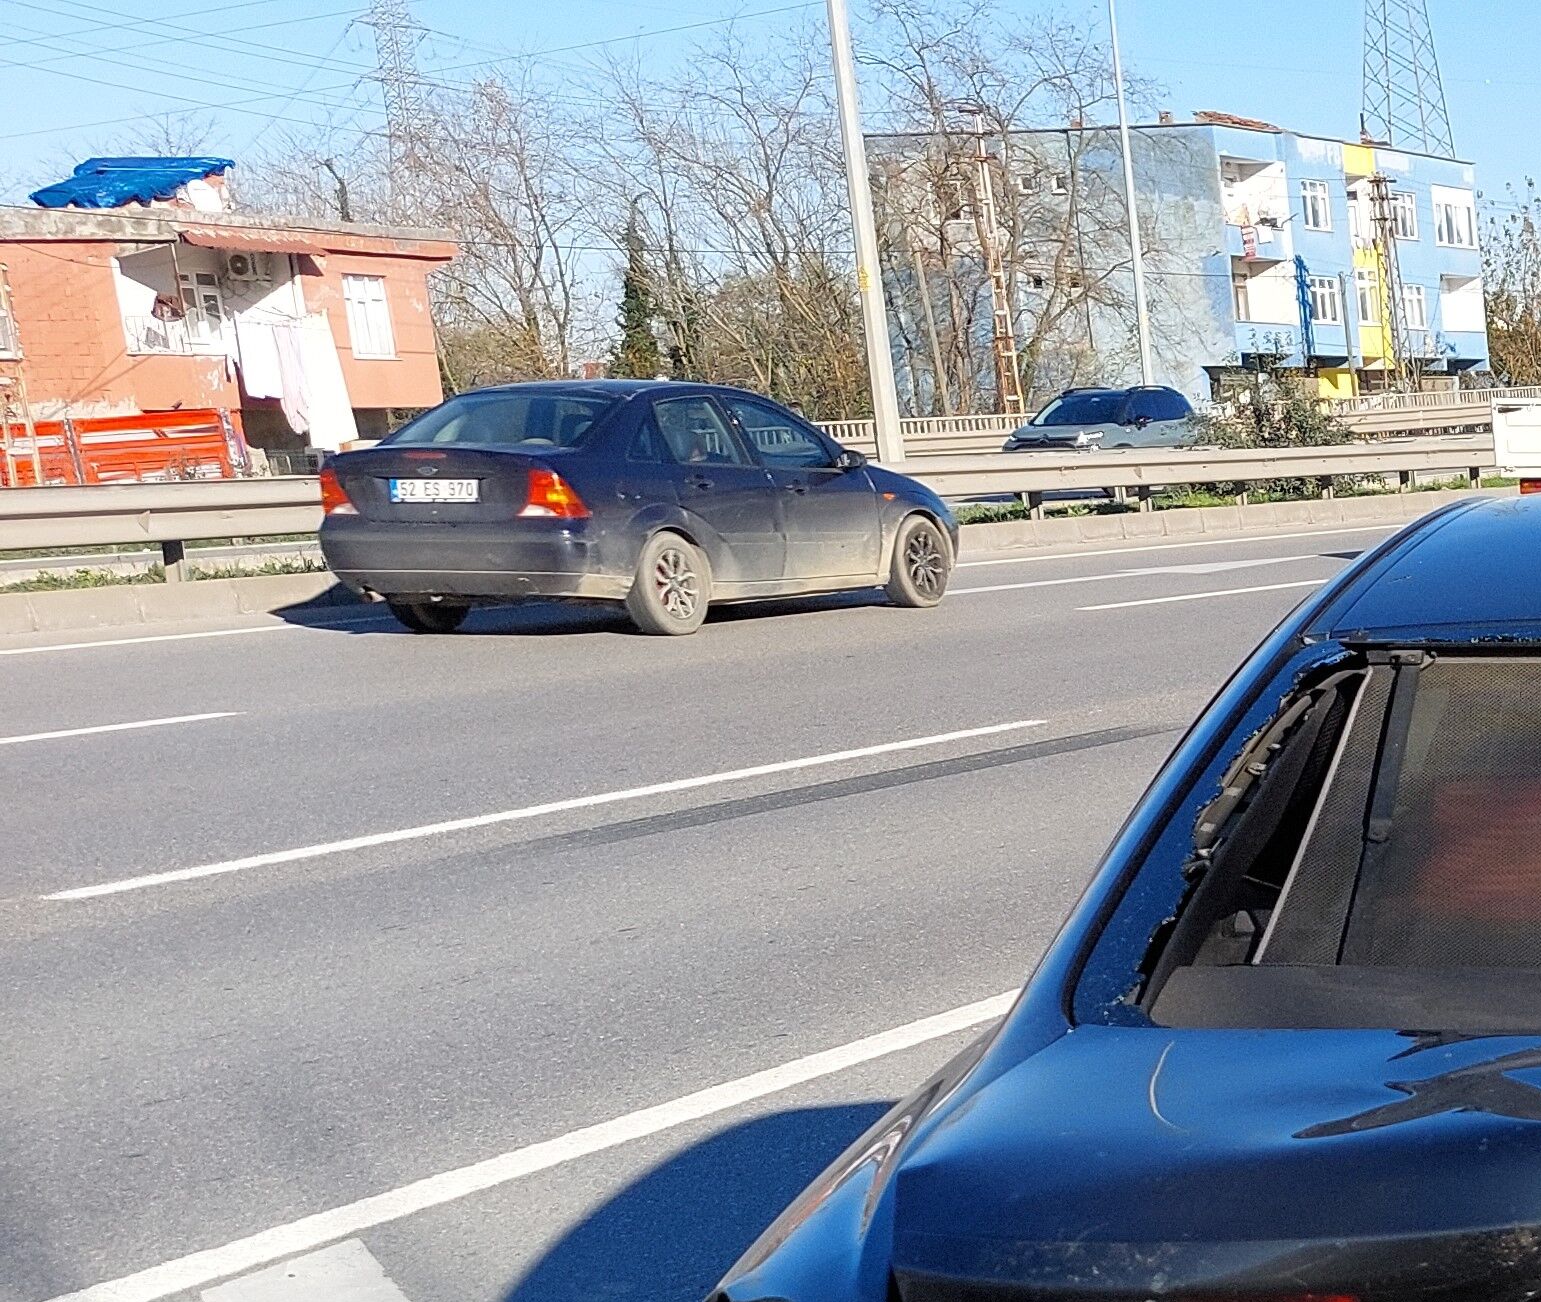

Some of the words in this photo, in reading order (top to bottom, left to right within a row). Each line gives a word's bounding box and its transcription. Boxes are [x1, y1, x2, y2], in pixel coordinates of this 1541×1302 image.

[400, 482, 416, 497] 52
[423, 482, 440, 497] ES
[448, 482, 473, 497] 970
